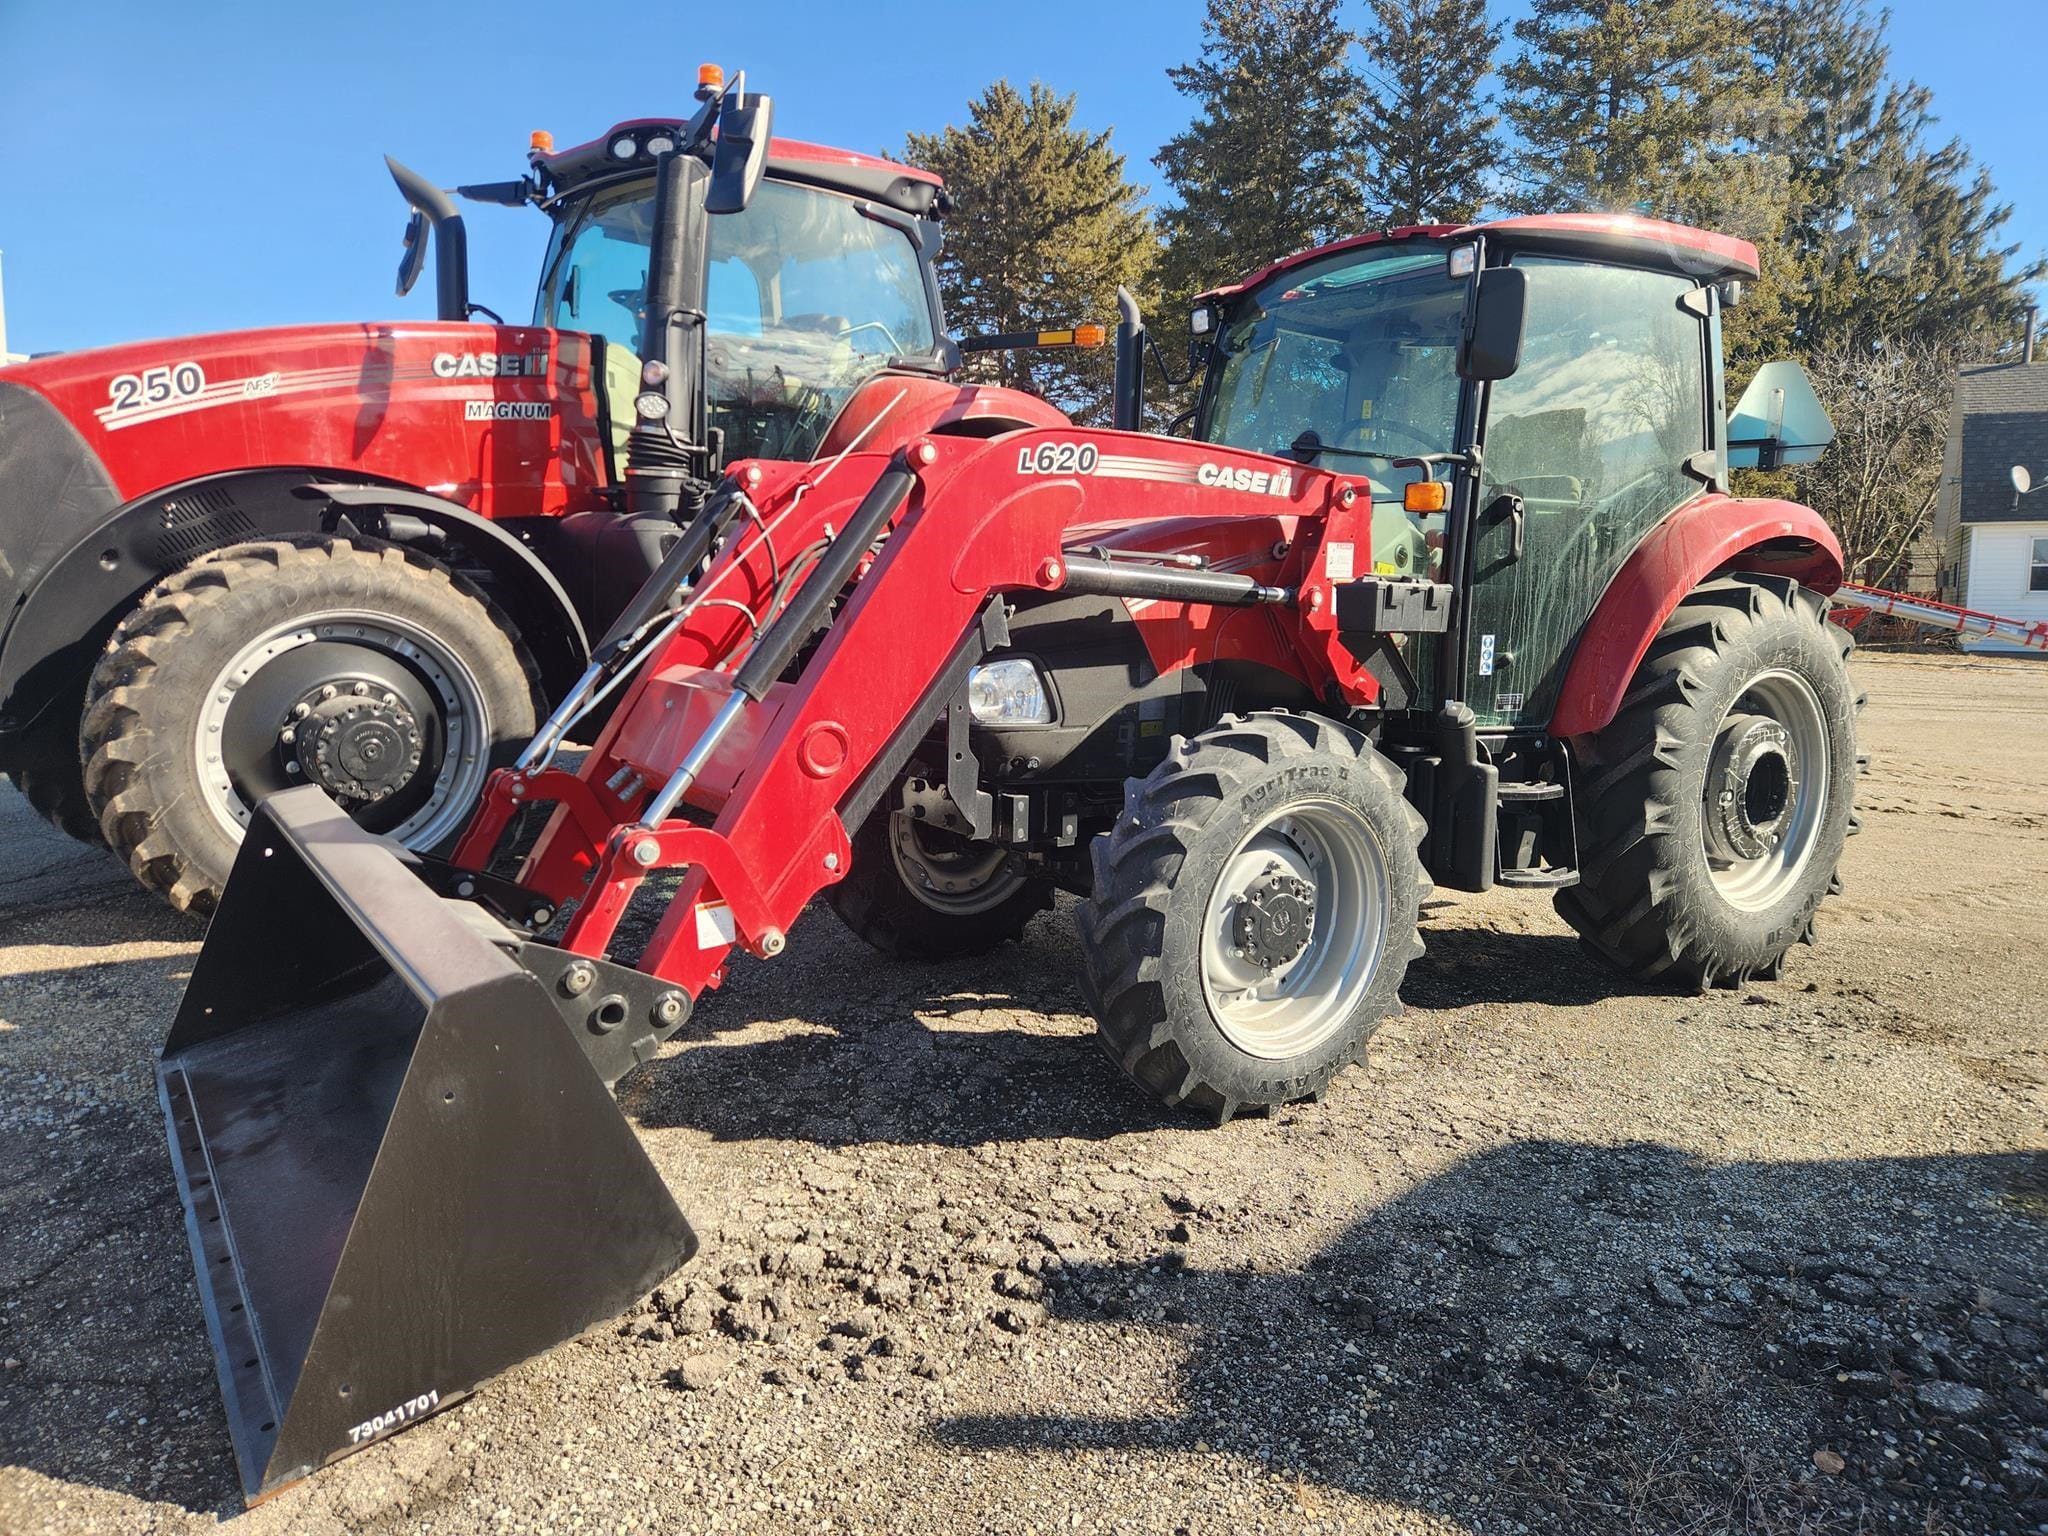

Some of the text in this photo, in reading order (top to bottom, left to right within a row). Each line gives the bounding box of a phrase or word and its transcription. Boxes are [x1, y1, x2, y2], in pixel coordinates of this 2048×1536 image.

[433, 352, 520, 378] CASE
[110, 362, 205, 413] 250
[466, 402, 550, 420] MAGNUM
[1018, 442, 1098, 474] L620
[1198, 463, 1267, 494] CASE
[1239, 765, 1329, 811] AgriTrac
[1255, 1040, 1357, 1095] GALAXY
[348, 1389, 440, 1444] 73041701
